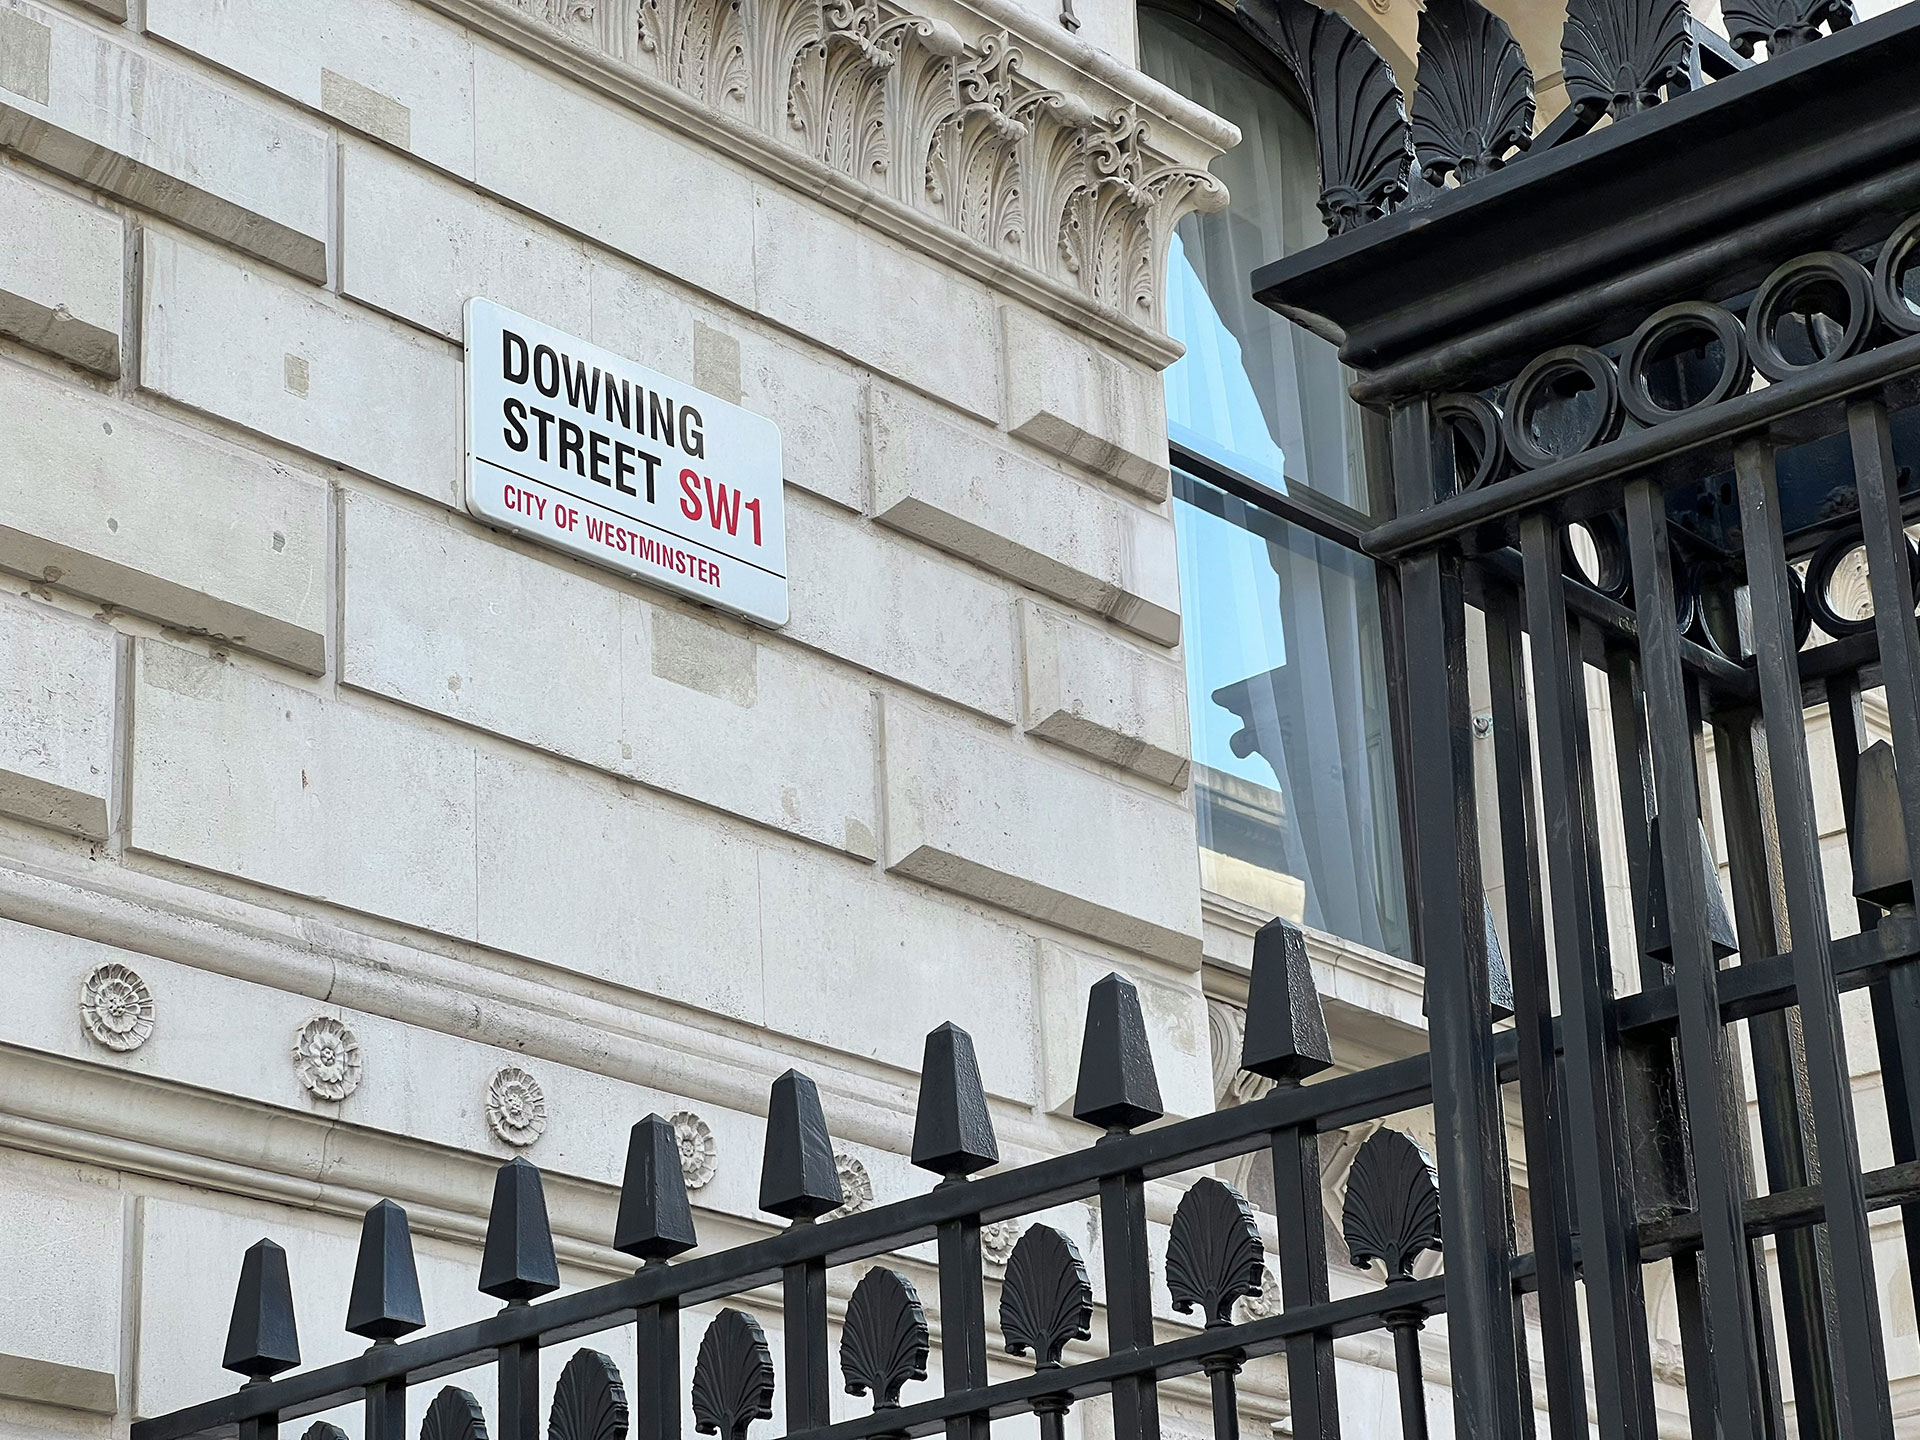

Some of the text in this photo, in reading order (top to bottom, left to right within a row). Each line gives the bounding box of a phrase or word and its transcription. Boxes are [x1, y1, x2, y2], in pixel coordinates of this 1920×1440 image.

[502, 328, 704, 460] DOWNING
[503, 397, 762, 547] STREET SW1
[503, 484, 721, 588] CITY OF WESTMINSTER
